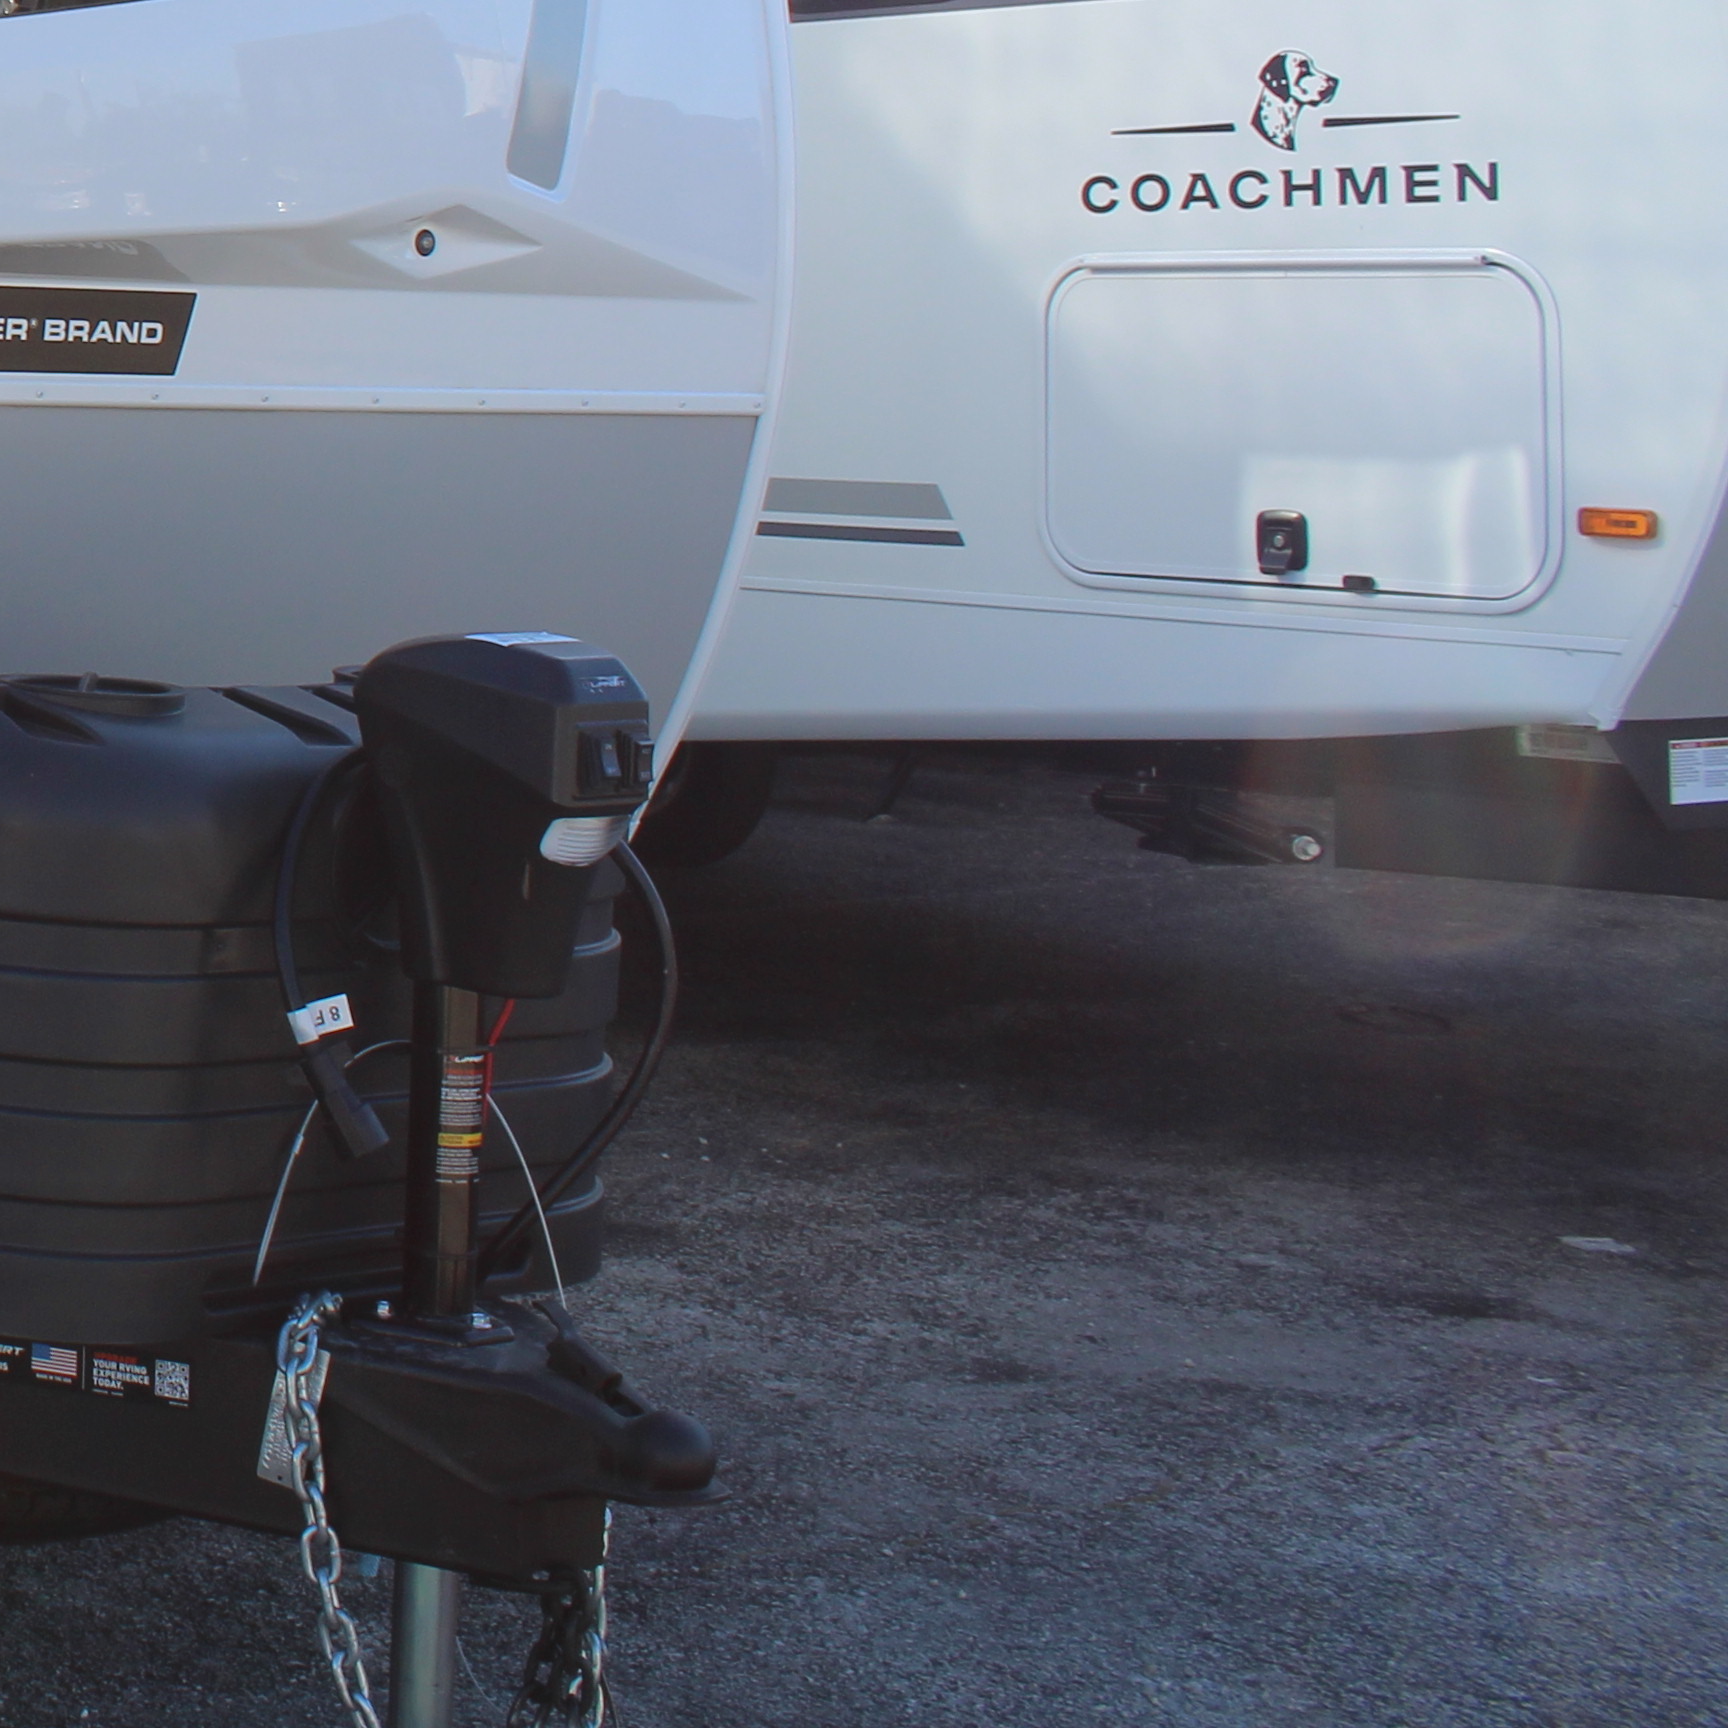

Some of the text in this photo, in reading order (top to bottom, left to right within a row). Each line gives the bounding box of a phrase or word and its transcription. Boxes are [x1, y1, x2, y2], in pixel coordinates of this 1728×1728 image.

[1080, 161, 1500, 215] COACHMEN
[43, 319, 164, 345] BRAND
[92, 1358, 117, 1370] YOUR
[92, 1367, 150, 1385] EXPERIENCE
